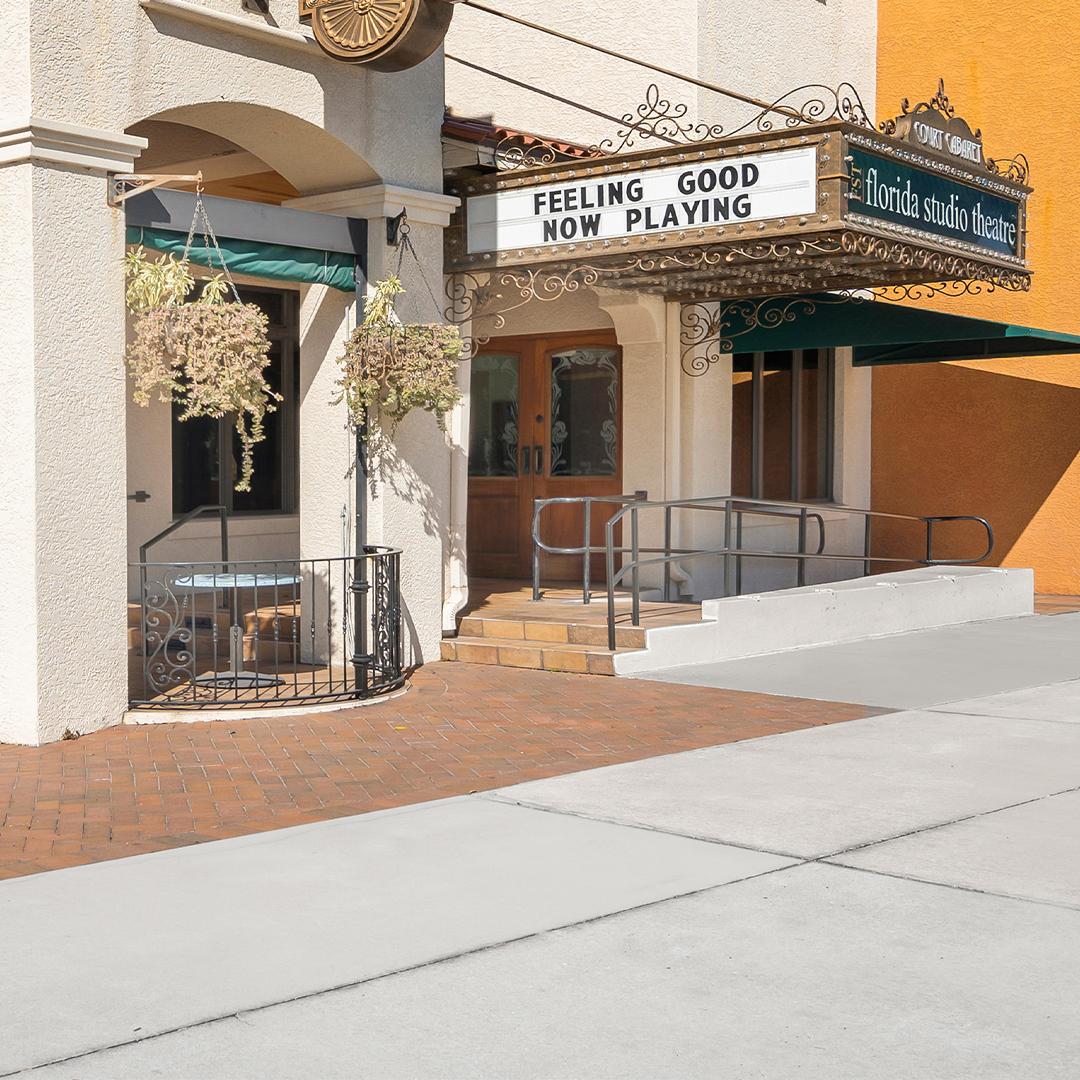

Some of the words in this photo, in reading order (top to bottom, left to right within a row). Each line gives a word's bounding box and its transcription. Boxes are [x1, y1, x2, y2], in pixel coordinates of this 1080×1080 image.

[914, 121, 944, 150] COURT
[945, 133, 982, 163] CABARET
[533, 178, 644, 216] FEELING
[677, 162, 760, 196] GOOD
[865, 167, 920, 219] florida
[923, 193, 968, 232] studio
[972, 203, 1017, 245] theatre
[543, 213, 602, 243] NOW
[626, 193, 752, 233] PLAYING
